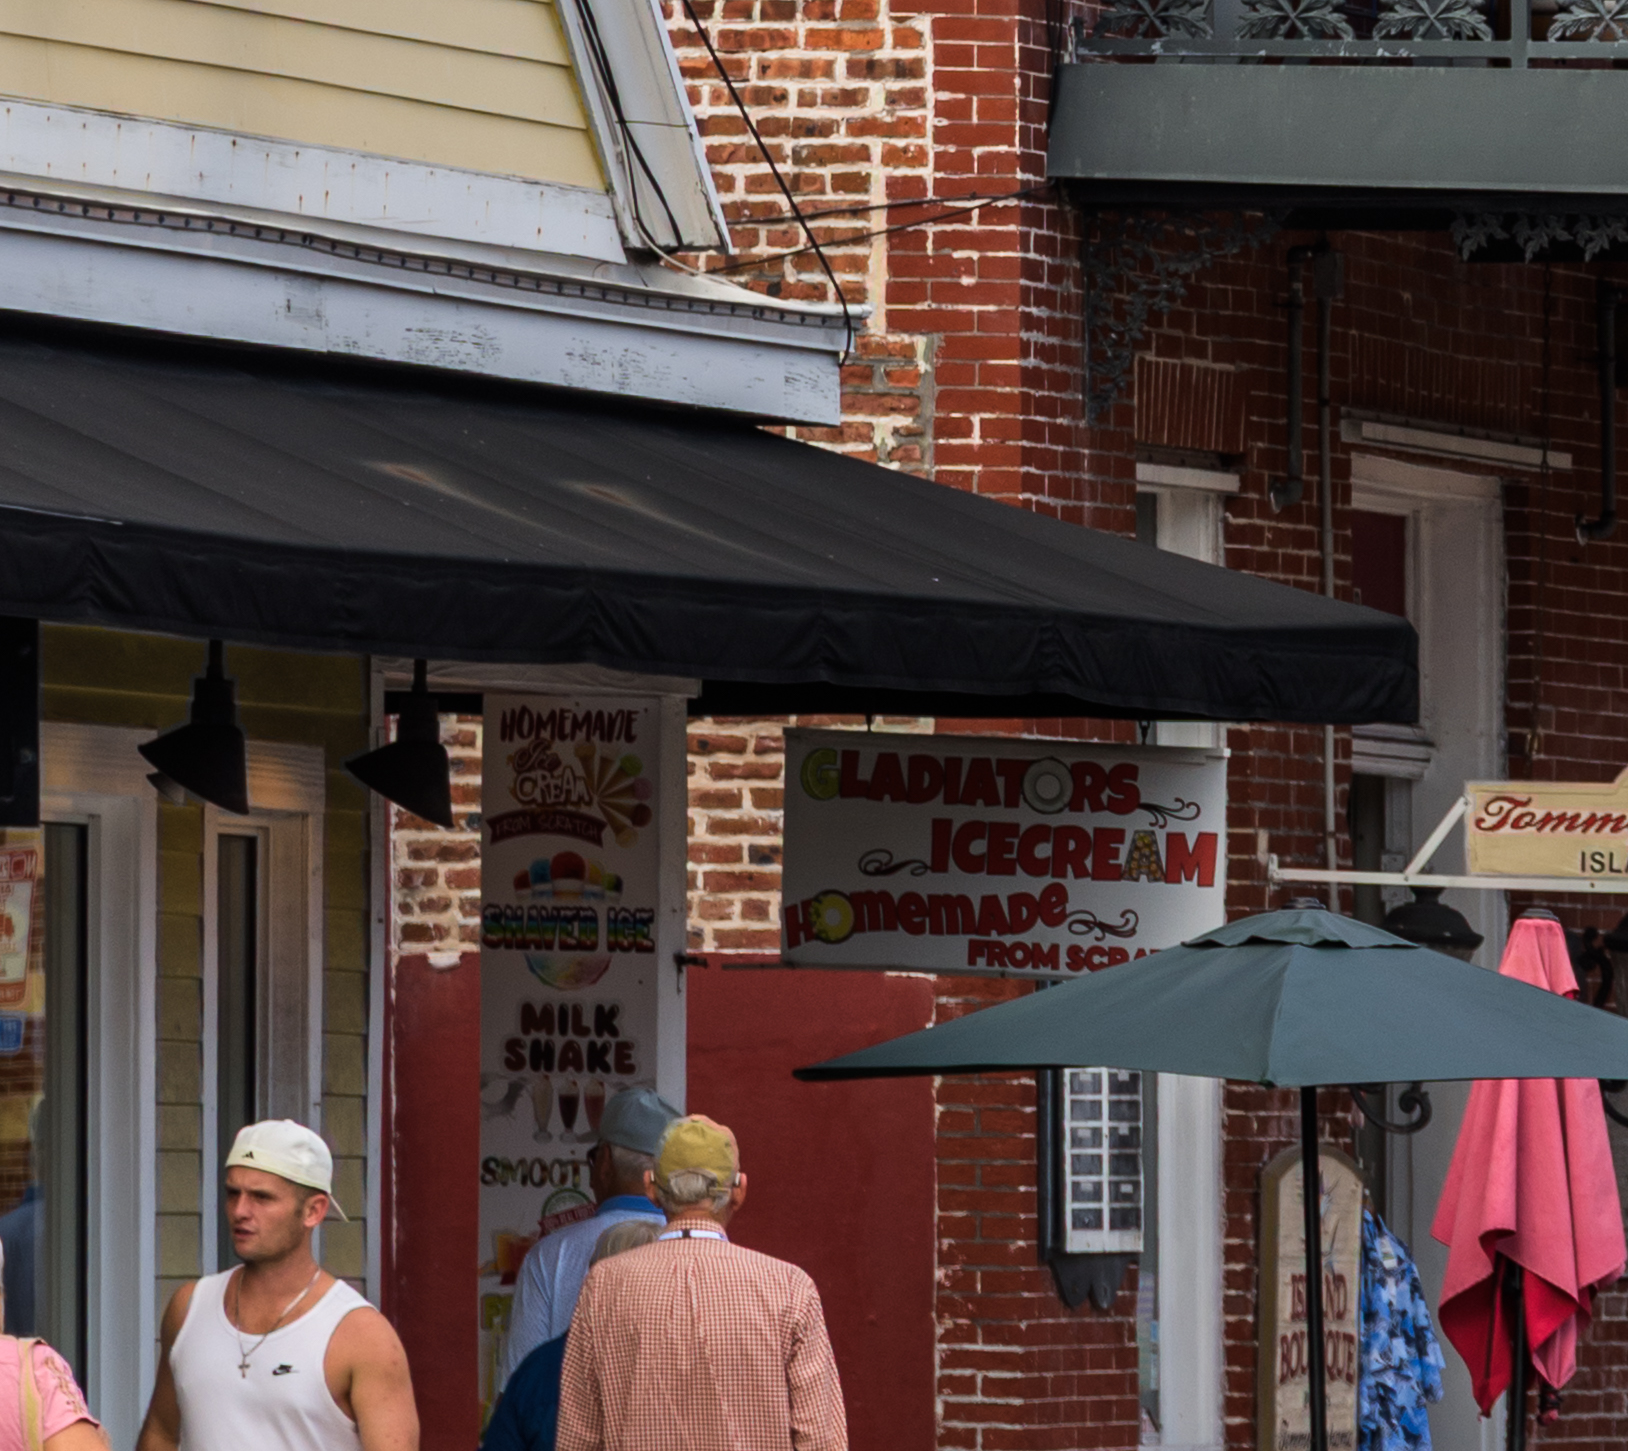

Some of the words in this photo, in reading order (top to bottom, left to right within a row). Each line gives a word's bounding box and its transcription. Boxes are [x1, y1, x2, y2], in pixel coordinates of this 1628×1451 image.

[500, 705, 640, 743] HOMEMADE
[513, 741, 562, 771] Ice
[515, 765, 593, 806] CREAM
[801, 748, 1142, 815] GLADIATORS
[496, 814, 532, 836] FROM
[537, 813, 598, 840] SCRATCH
[931, 817, 1218, 888] ICECREAM
[482, 903, 599, 951] SHAVED
[606, 905, 656, 953] ICE
[967, 938, 1060, 971] FROM
[520, 1002, 621, 1038] MILK
[504, 1038, 637, 1075] SHAKE
